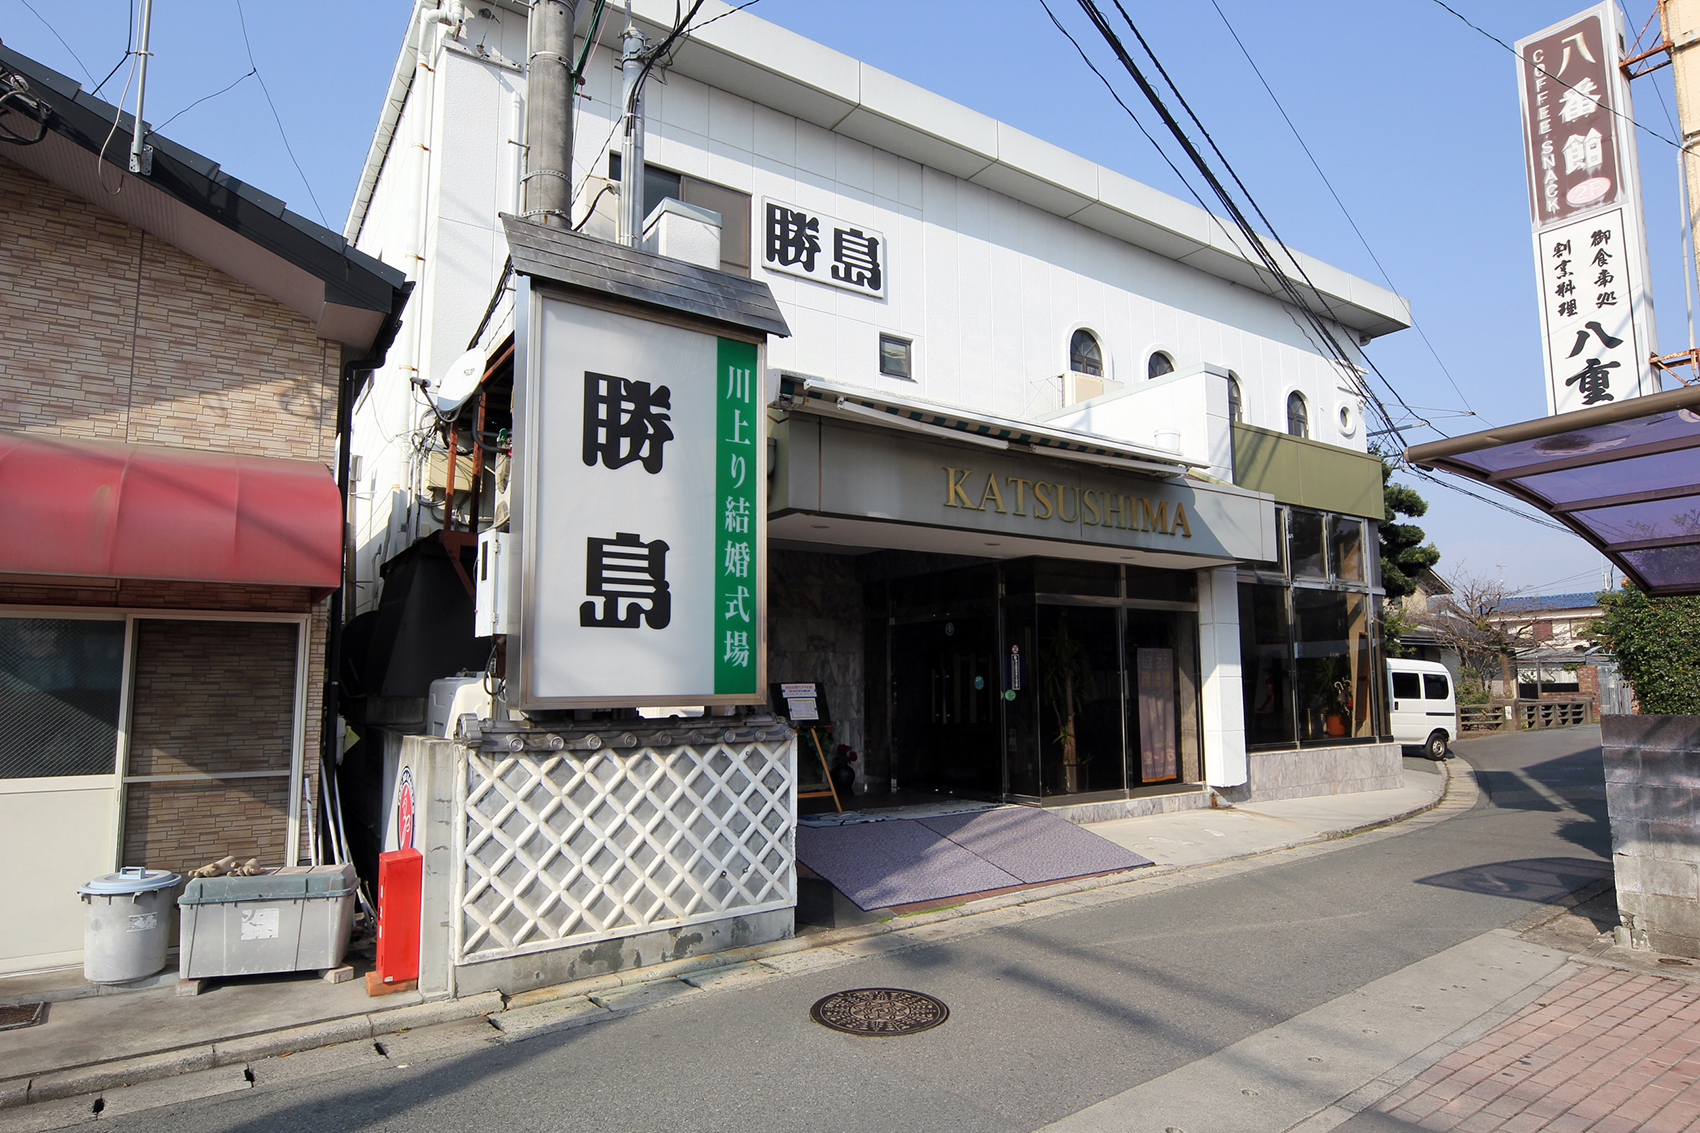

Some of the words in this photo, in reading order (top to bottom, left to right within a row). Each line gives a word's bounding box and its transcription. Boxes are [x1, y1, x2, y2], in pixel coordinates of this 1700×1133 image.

[1557, 33, 1602, 175] 八番館
[1541, 140, 1559, 212] SNACK
[1574, 179, 1602, 202] 2F
[766, 202, 882, 290] 勝島
[1552, 239, 1578, 317] 割烹料理
[1566, 321, 1624, 405] 八重
[580, 372, 674, 630] 勝島
[724, 365, 751, 668] 川上り結婚式場
[943, 466, 1192, 537] KATSUSHIMA
